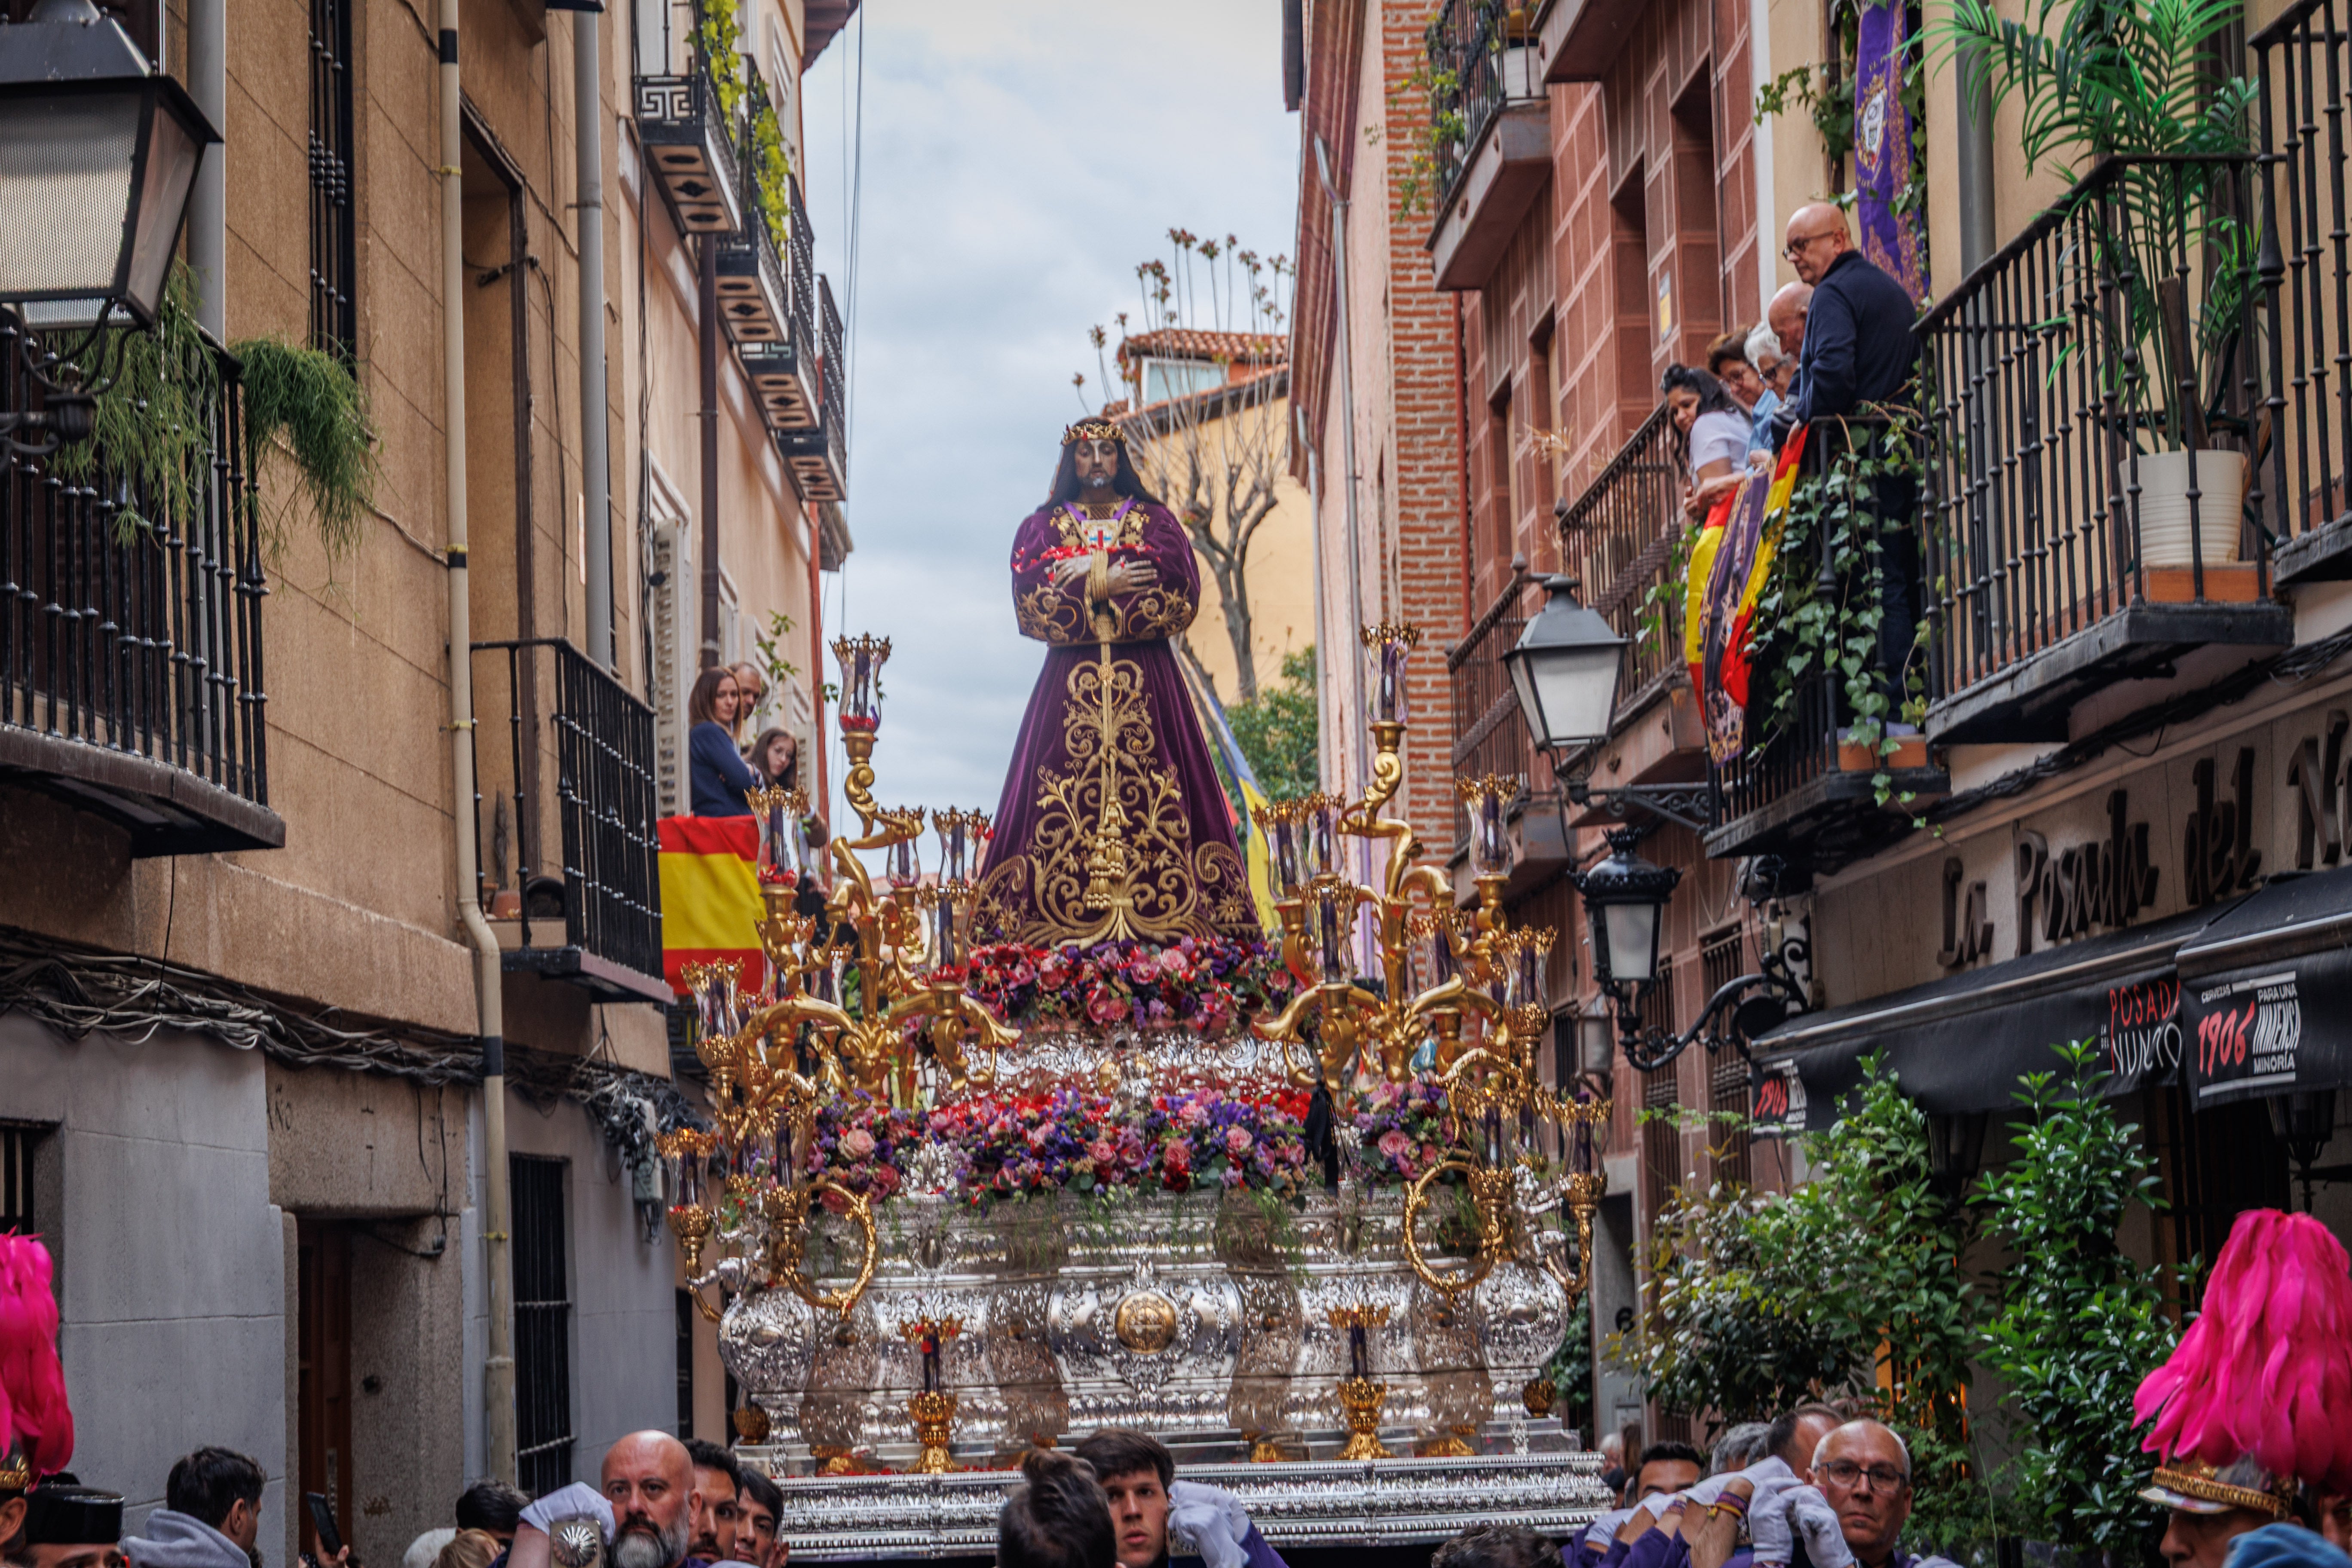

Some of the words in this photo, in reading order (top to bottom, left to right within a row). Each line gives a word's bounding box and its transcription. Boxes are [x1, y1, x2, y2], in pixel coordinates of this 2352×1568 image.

[1937, 857, 1994, 967] La
[2012, 789, 2159, 958] Posada
[2184, 745, 2262, 905] del
[2202, 984, 2231, 1004] CERVEZAS
[2258, 986, 2279, 1004] PARA
[2279, 983, 2297, 999] UNA
[2198, 999, 2255, 1078] 1906
[2253, 998, 2301, 1055] INMENSA
[2254, 1050, 2295, 1074] MINORÍA
[1754, 1074, 1788, 1121] 1906
